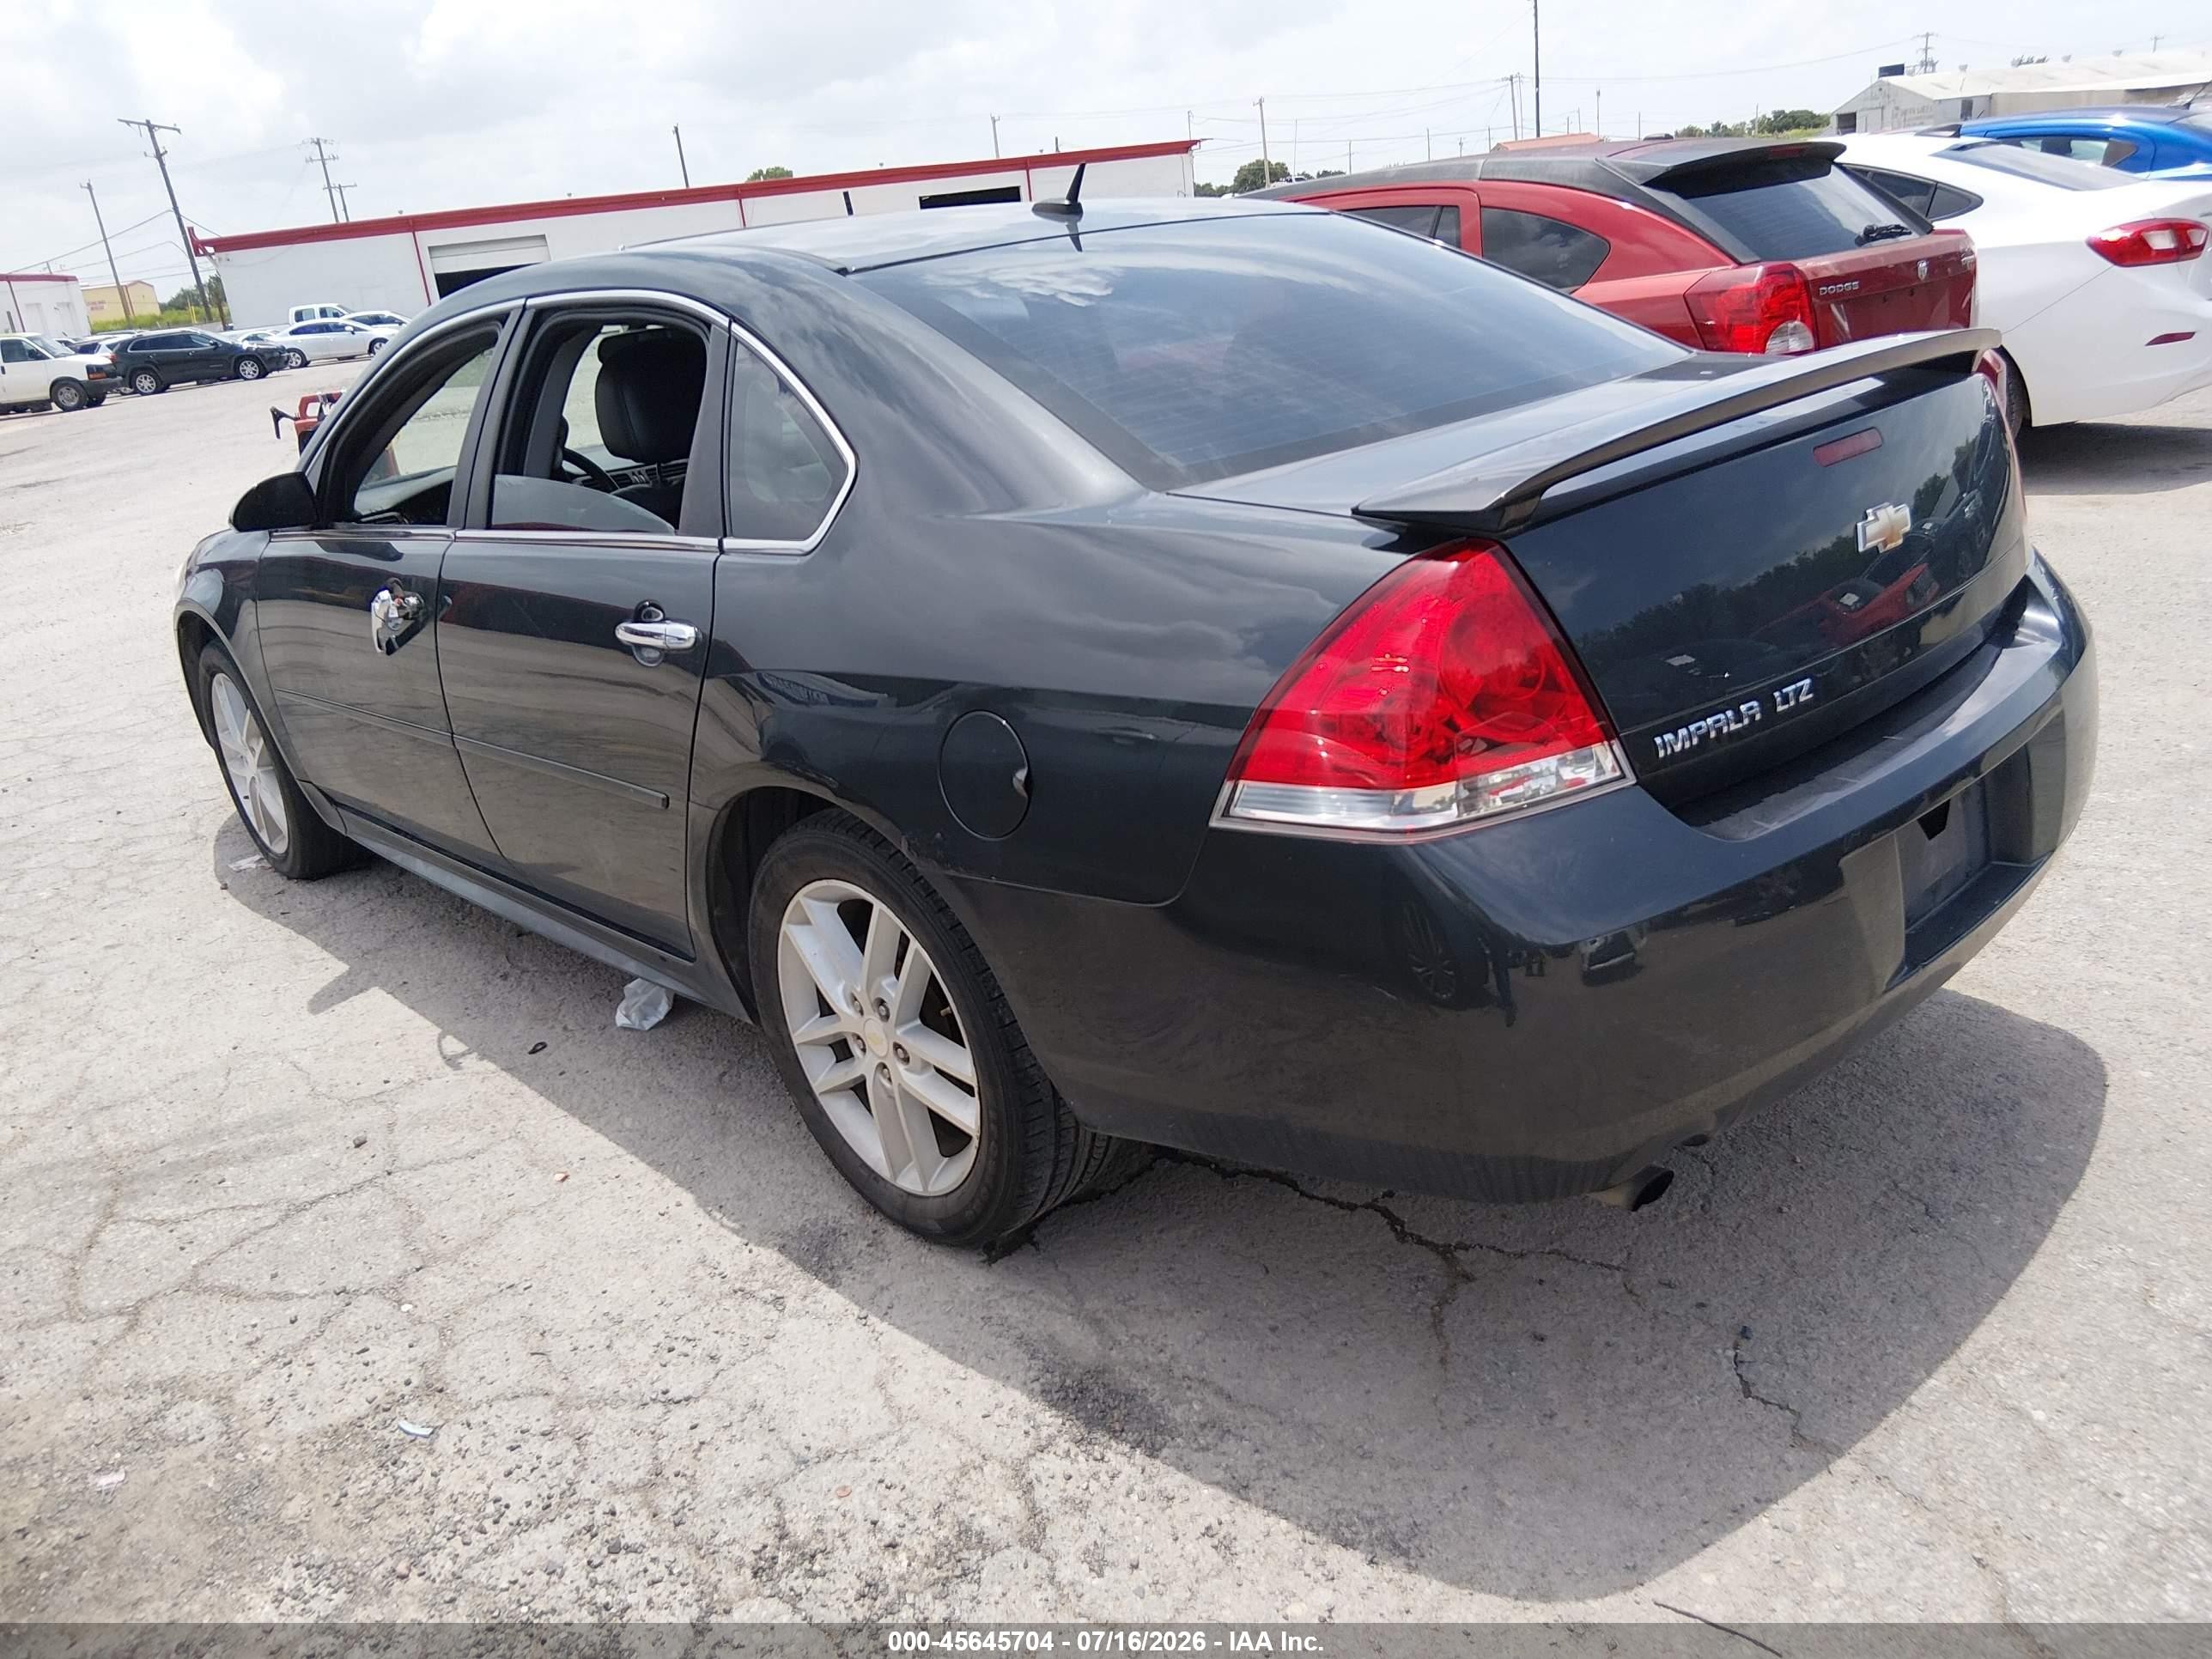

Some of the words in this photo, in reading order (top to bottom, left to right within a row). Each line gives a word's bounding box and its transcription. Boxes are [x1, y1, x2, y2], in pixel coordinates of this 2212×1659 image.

[1819, 281, 1860, 295] DODGE
[1654, 700, 1762, 758] IMPALA
[1773, 678, 1814, 713] LTZ
